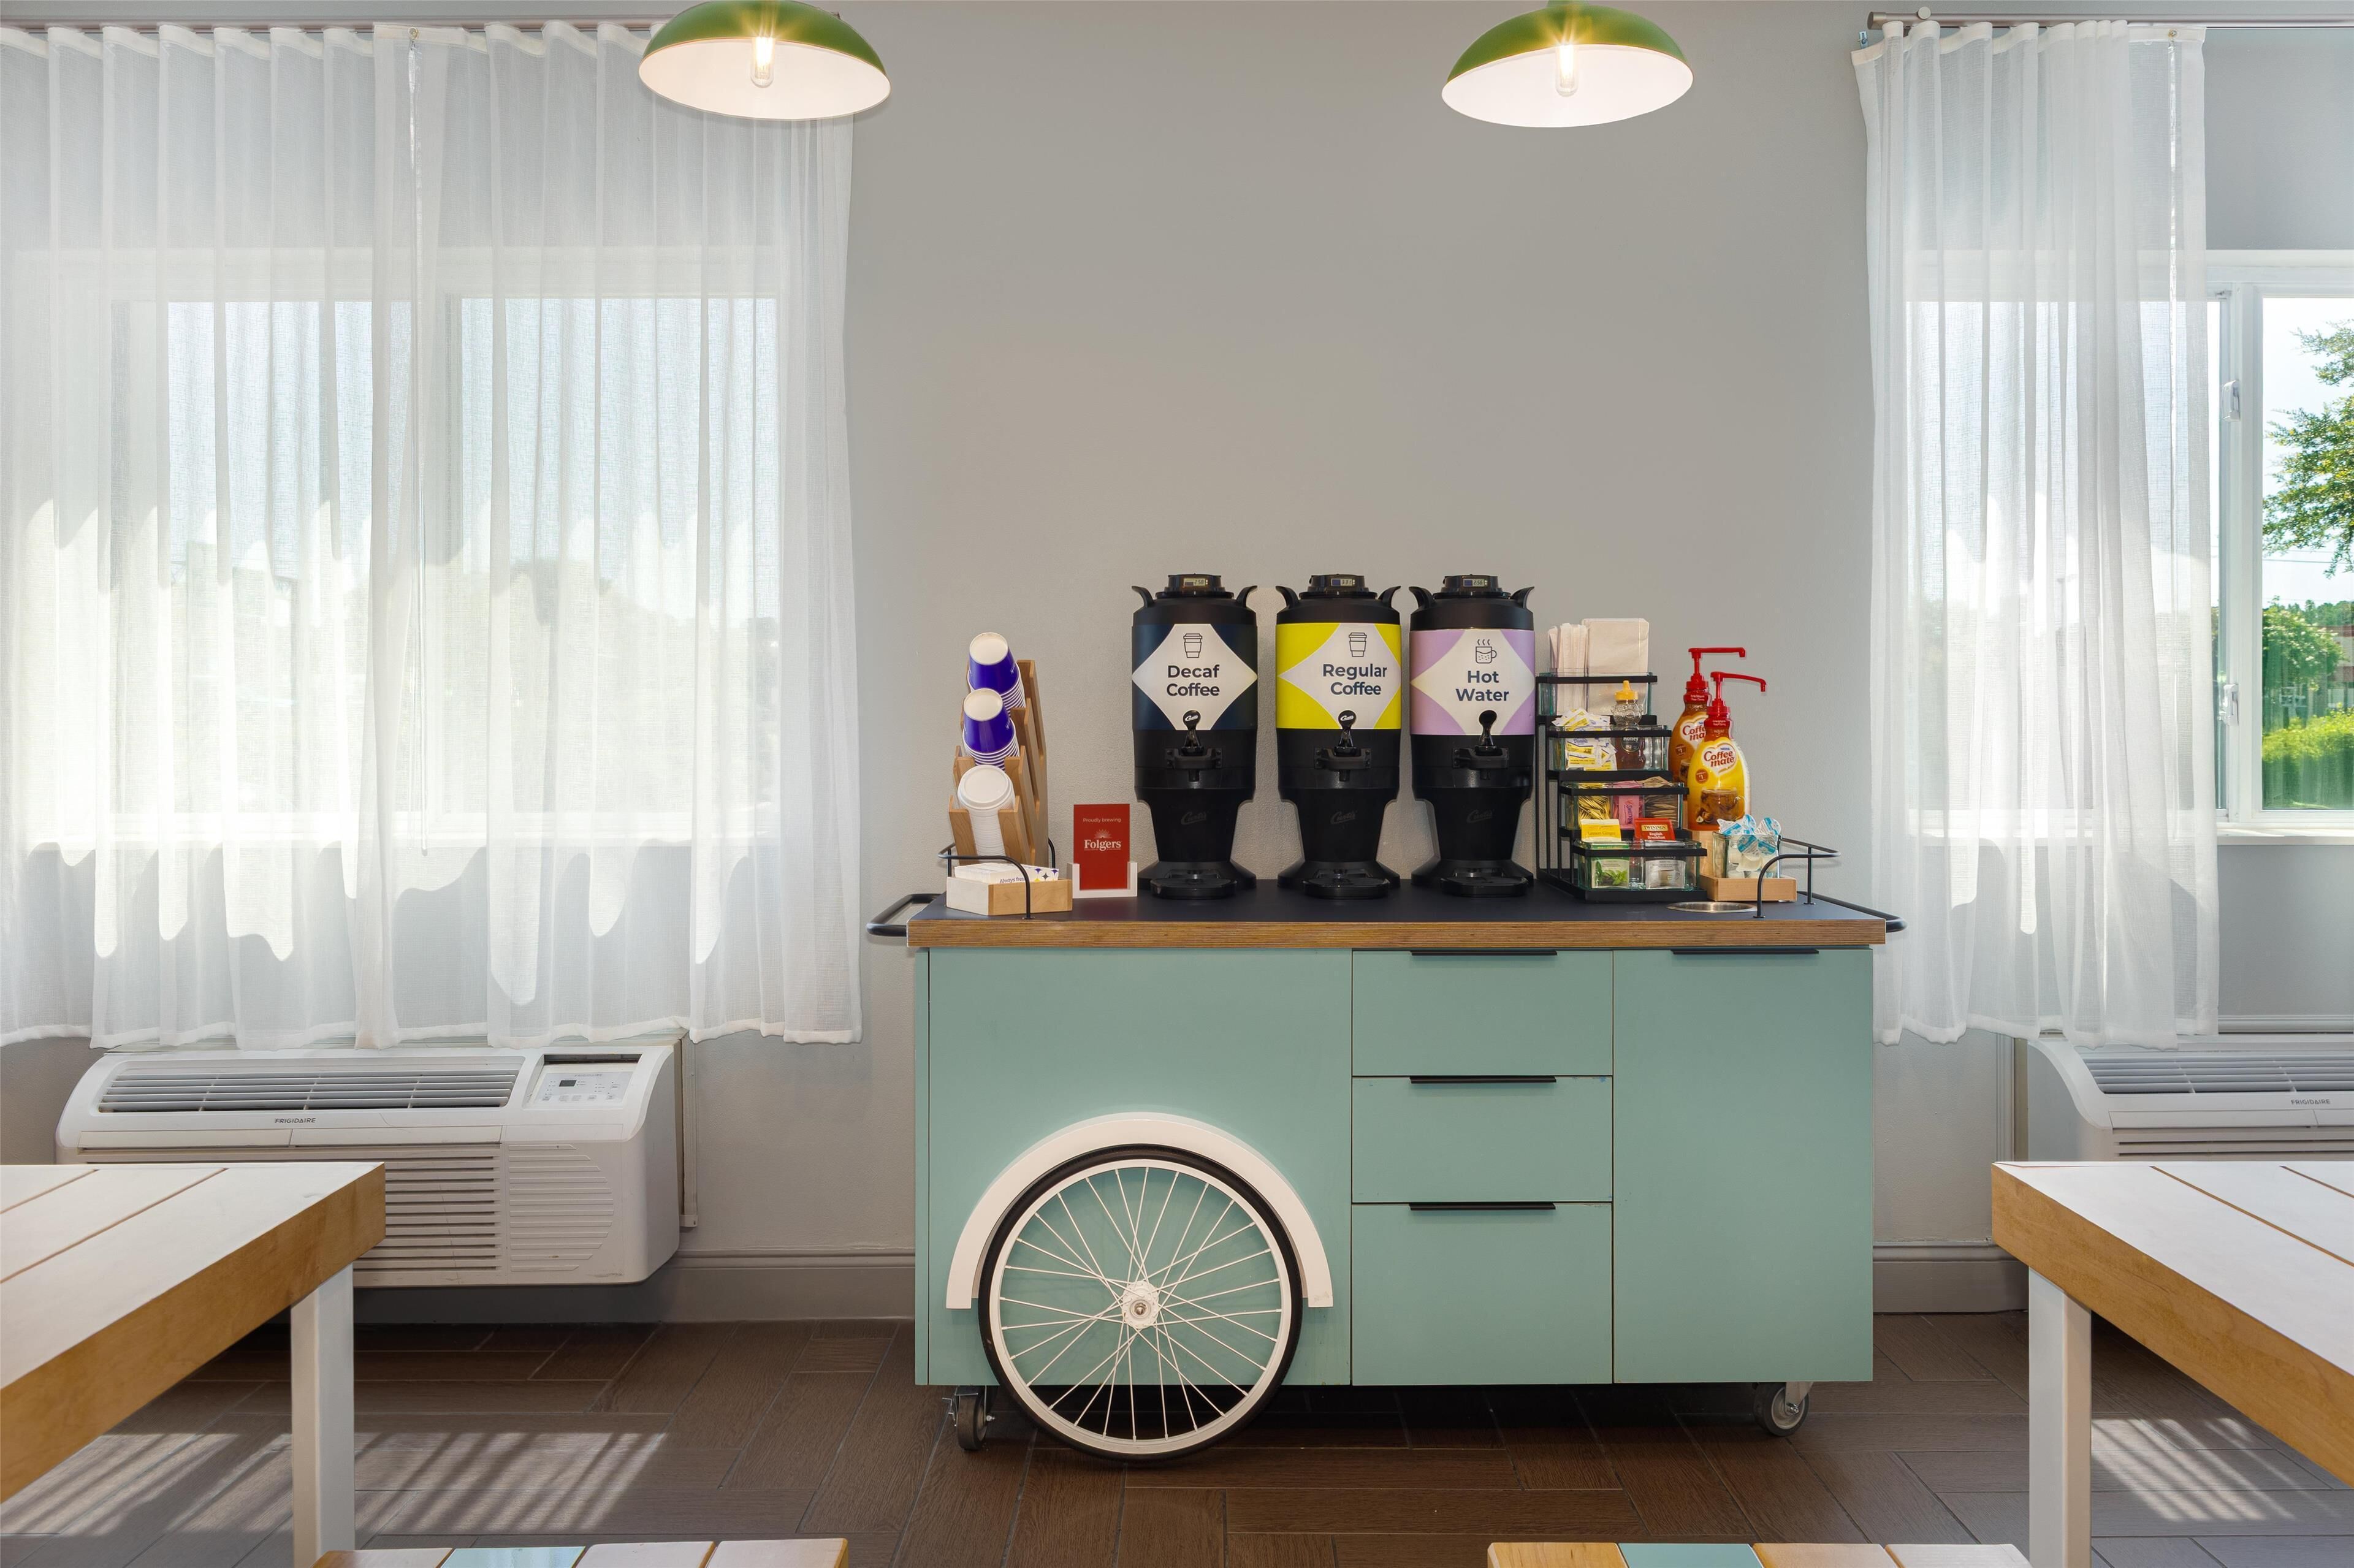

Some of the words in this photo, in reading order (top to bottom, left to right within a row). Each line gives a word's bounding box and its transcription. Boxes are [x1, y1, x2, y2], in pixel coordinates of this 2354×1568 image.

[1167, 664, 1220, 678] Decaf
[1323, 663, 1387, 680] Regular
[1467, 670, 1500, 683] Hot
[1166, 682, 1220, 697] Coffee
[1330, 681, 1382, 696] Coffee
[1455, 688, 1510, 702] Water
[1682, 725, 1707, 736] Coffe
[1689, 733, 1705, 741] ma
[1704, 751, 1734, 762] Coffee
[1710, 756, 1735, 767] mate
[1084, 839, 1121, 851] Folgers
